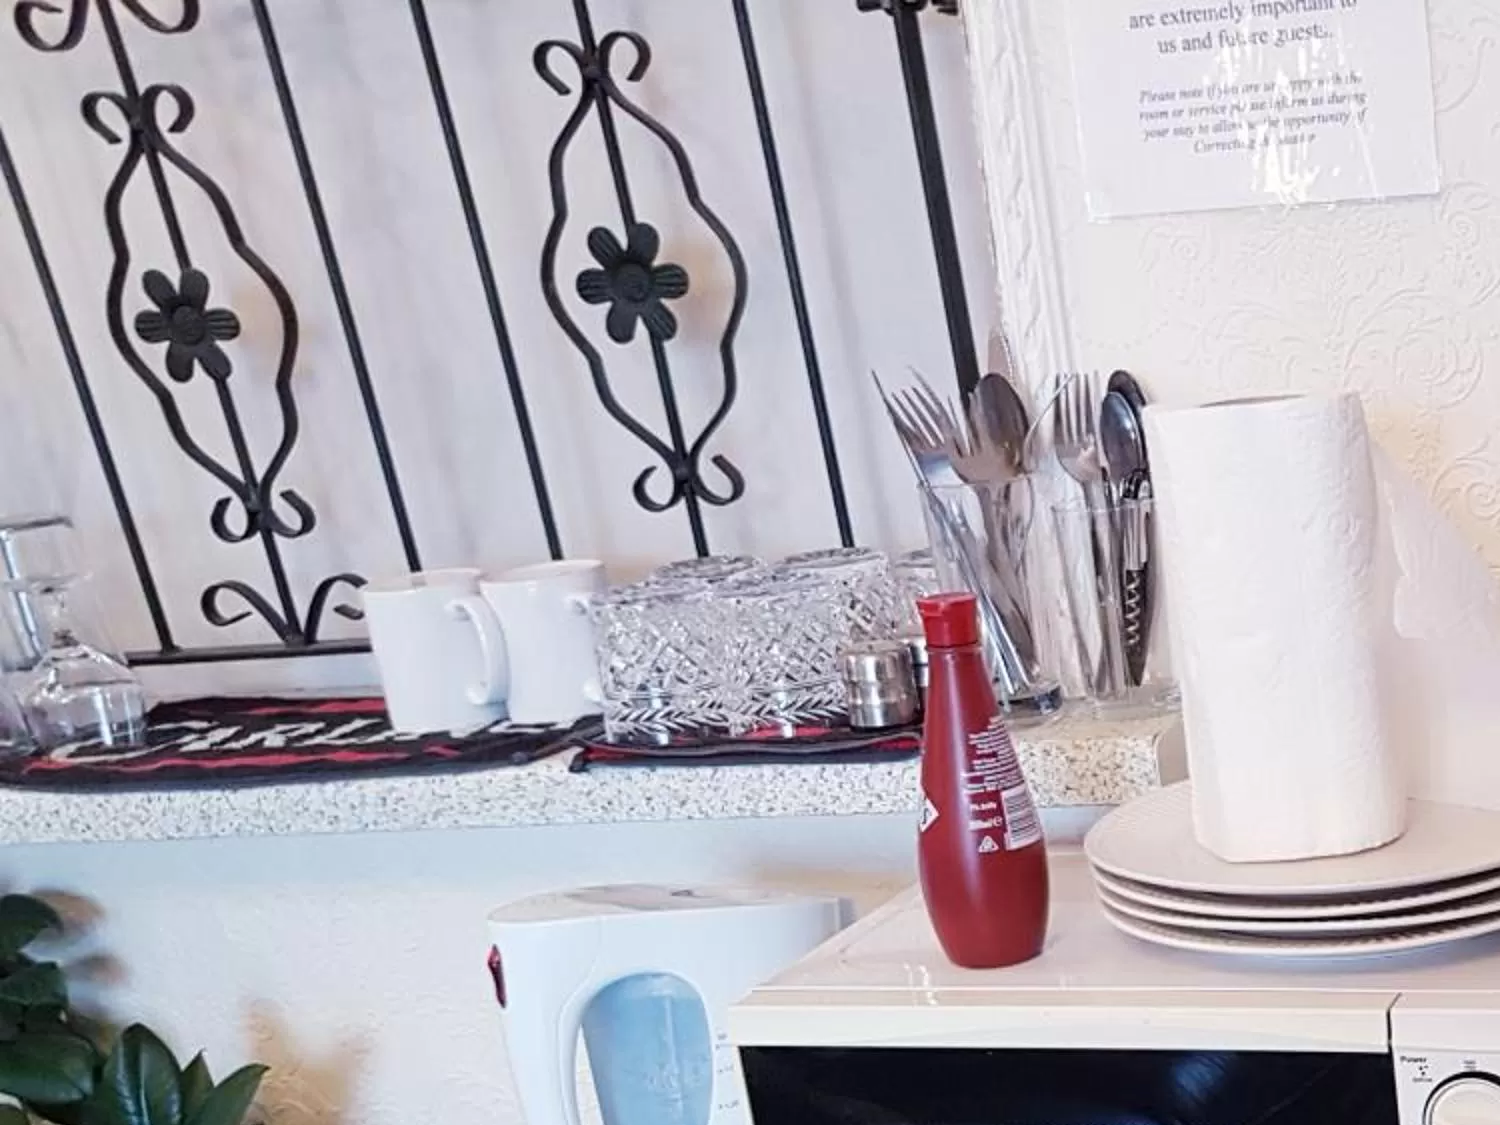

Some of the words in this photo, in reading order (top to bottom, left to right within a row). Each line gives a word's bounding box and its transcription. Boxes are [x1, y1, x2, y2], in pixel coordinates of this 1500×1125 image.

[1129, 14, 1155, 29] are
[1160, 0, 1244, 24] extremely
[1251, 0, 1334, 20] important
[1157, 39, 1177, 53] us
[1182, 31, 1213, 52] and
[1219, 29, 1269, 48] futre
